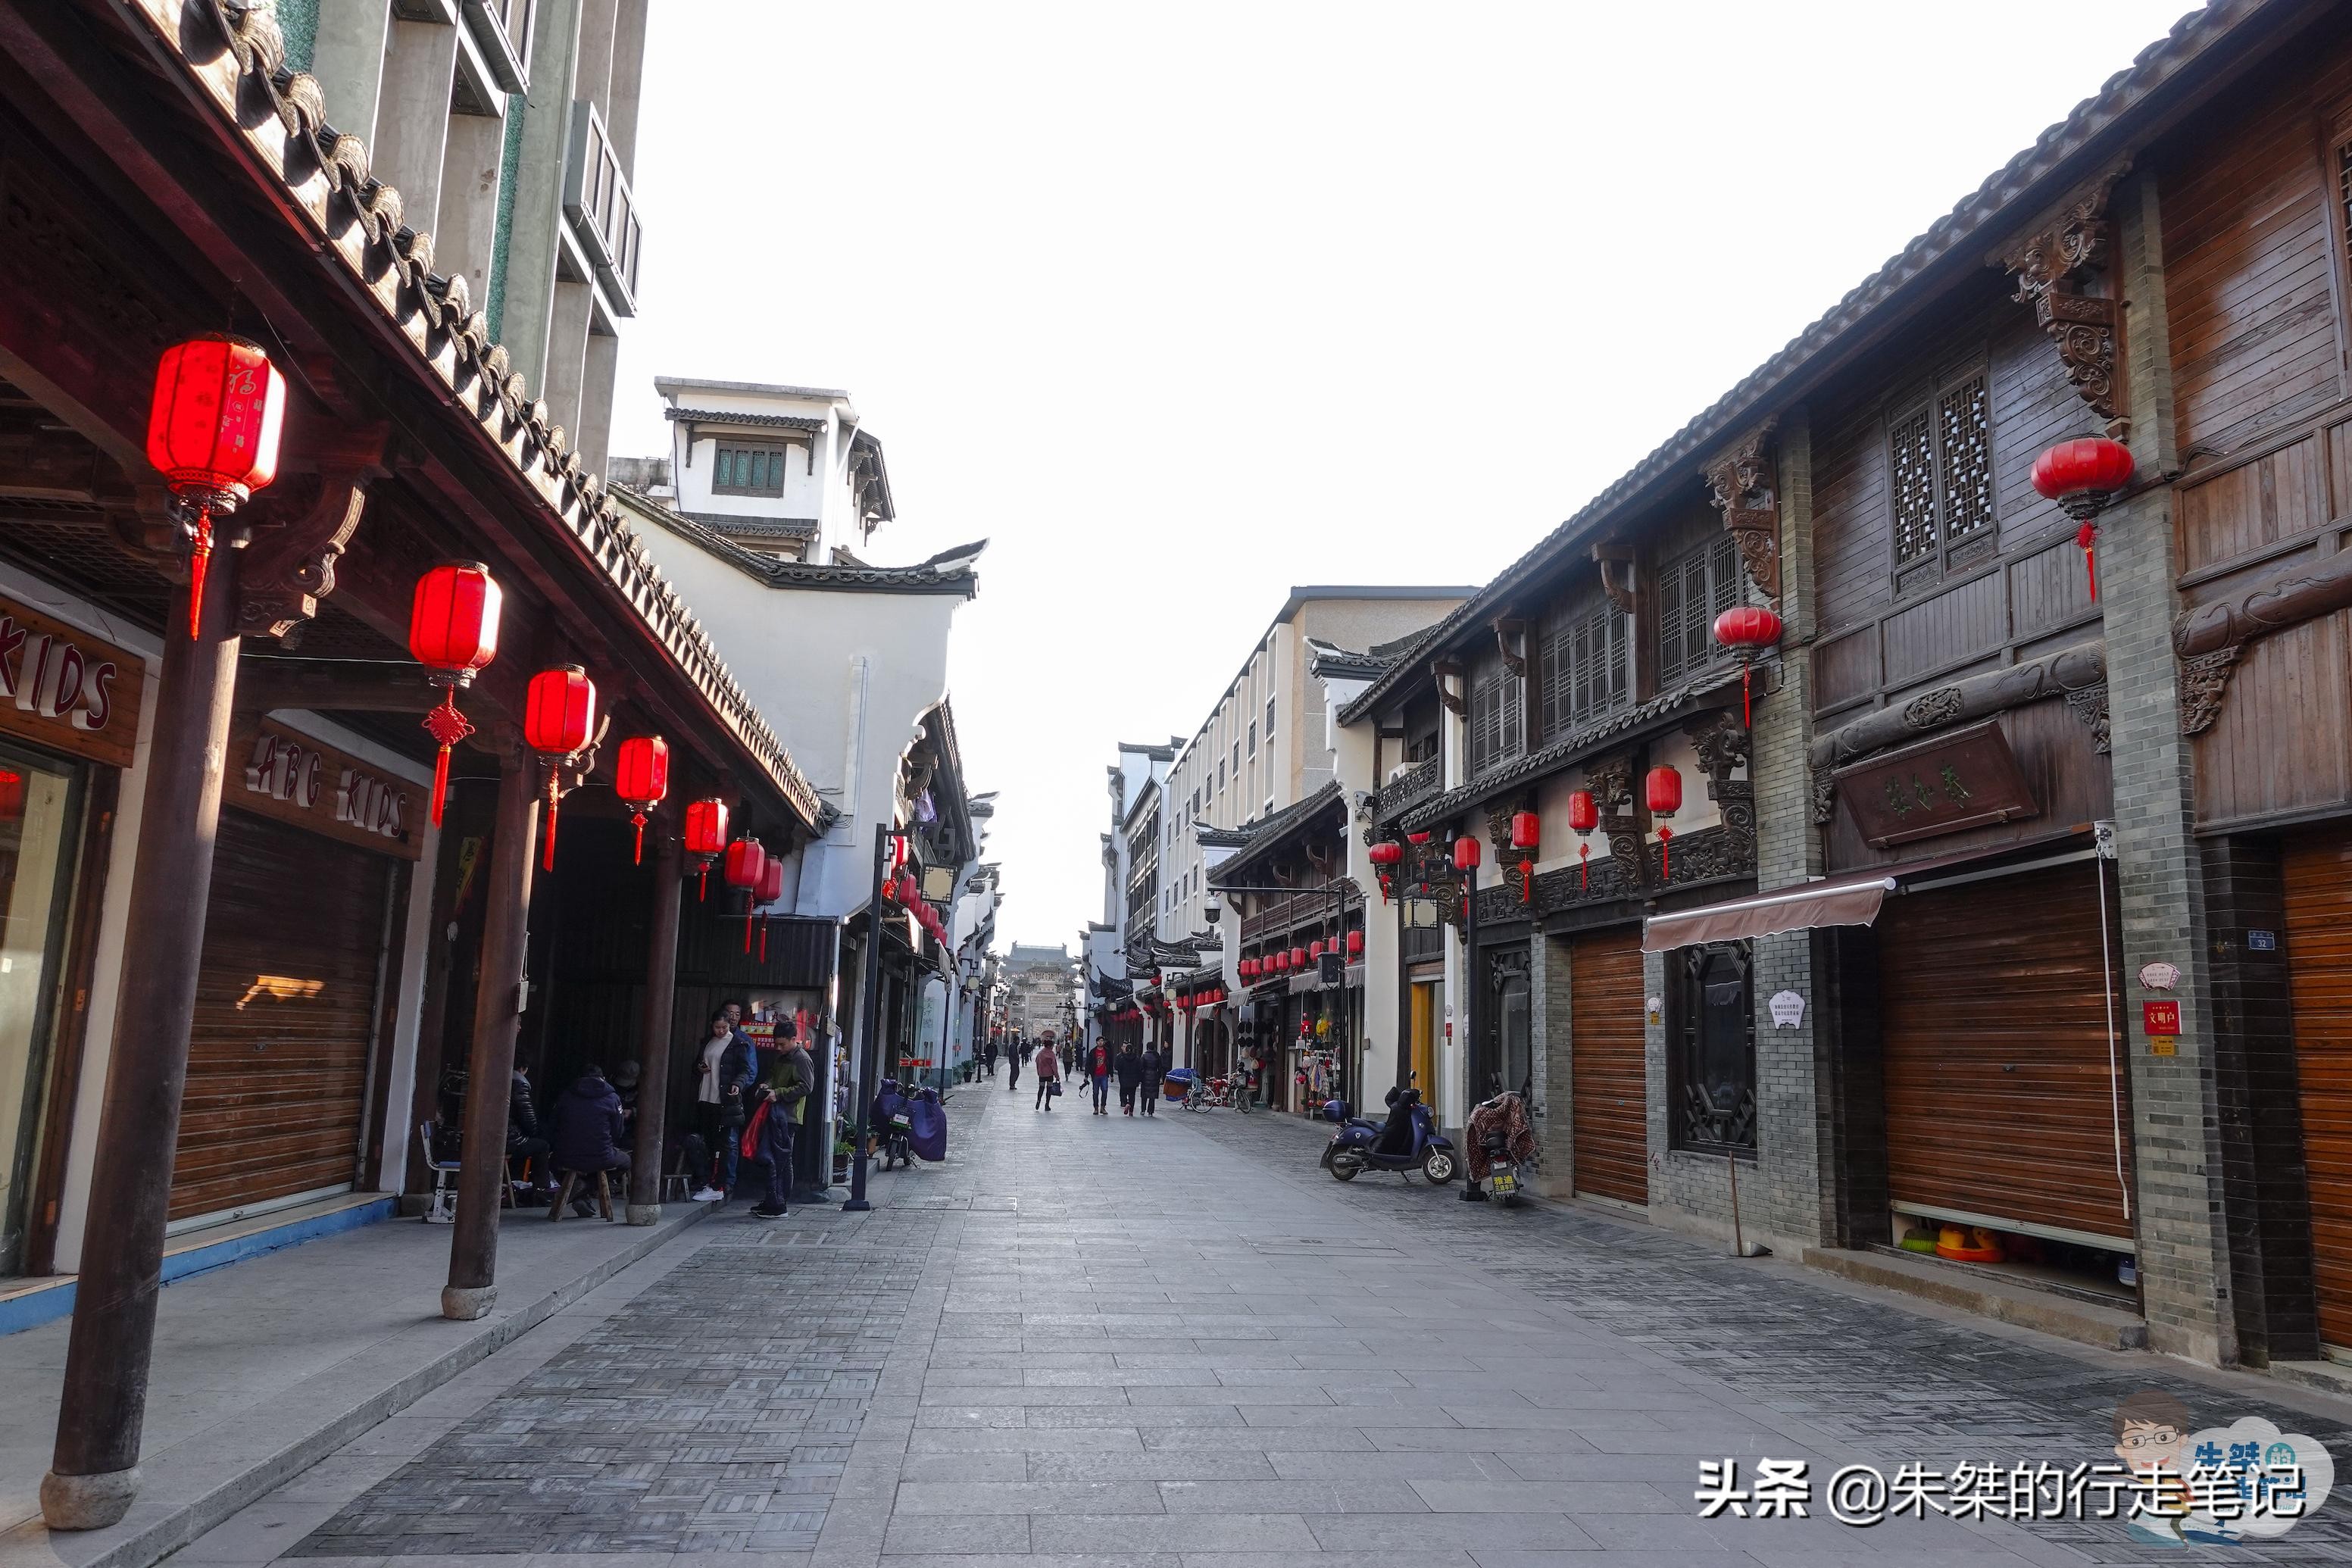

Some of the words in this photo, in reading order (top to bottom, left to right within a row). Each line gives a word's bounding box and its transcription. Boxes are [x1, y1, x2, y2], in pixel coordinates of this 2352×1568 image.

[0, 616, 117, 730] KIDS
[246, 734, 321, 807] ABC
[336, 768, 407, 838] KIDS
[2257, 939, 2267, 948] 32
[2148, 1011, 2176, 1024] 文明户
[1493, 1176, 1513, 1185] 雅迪
